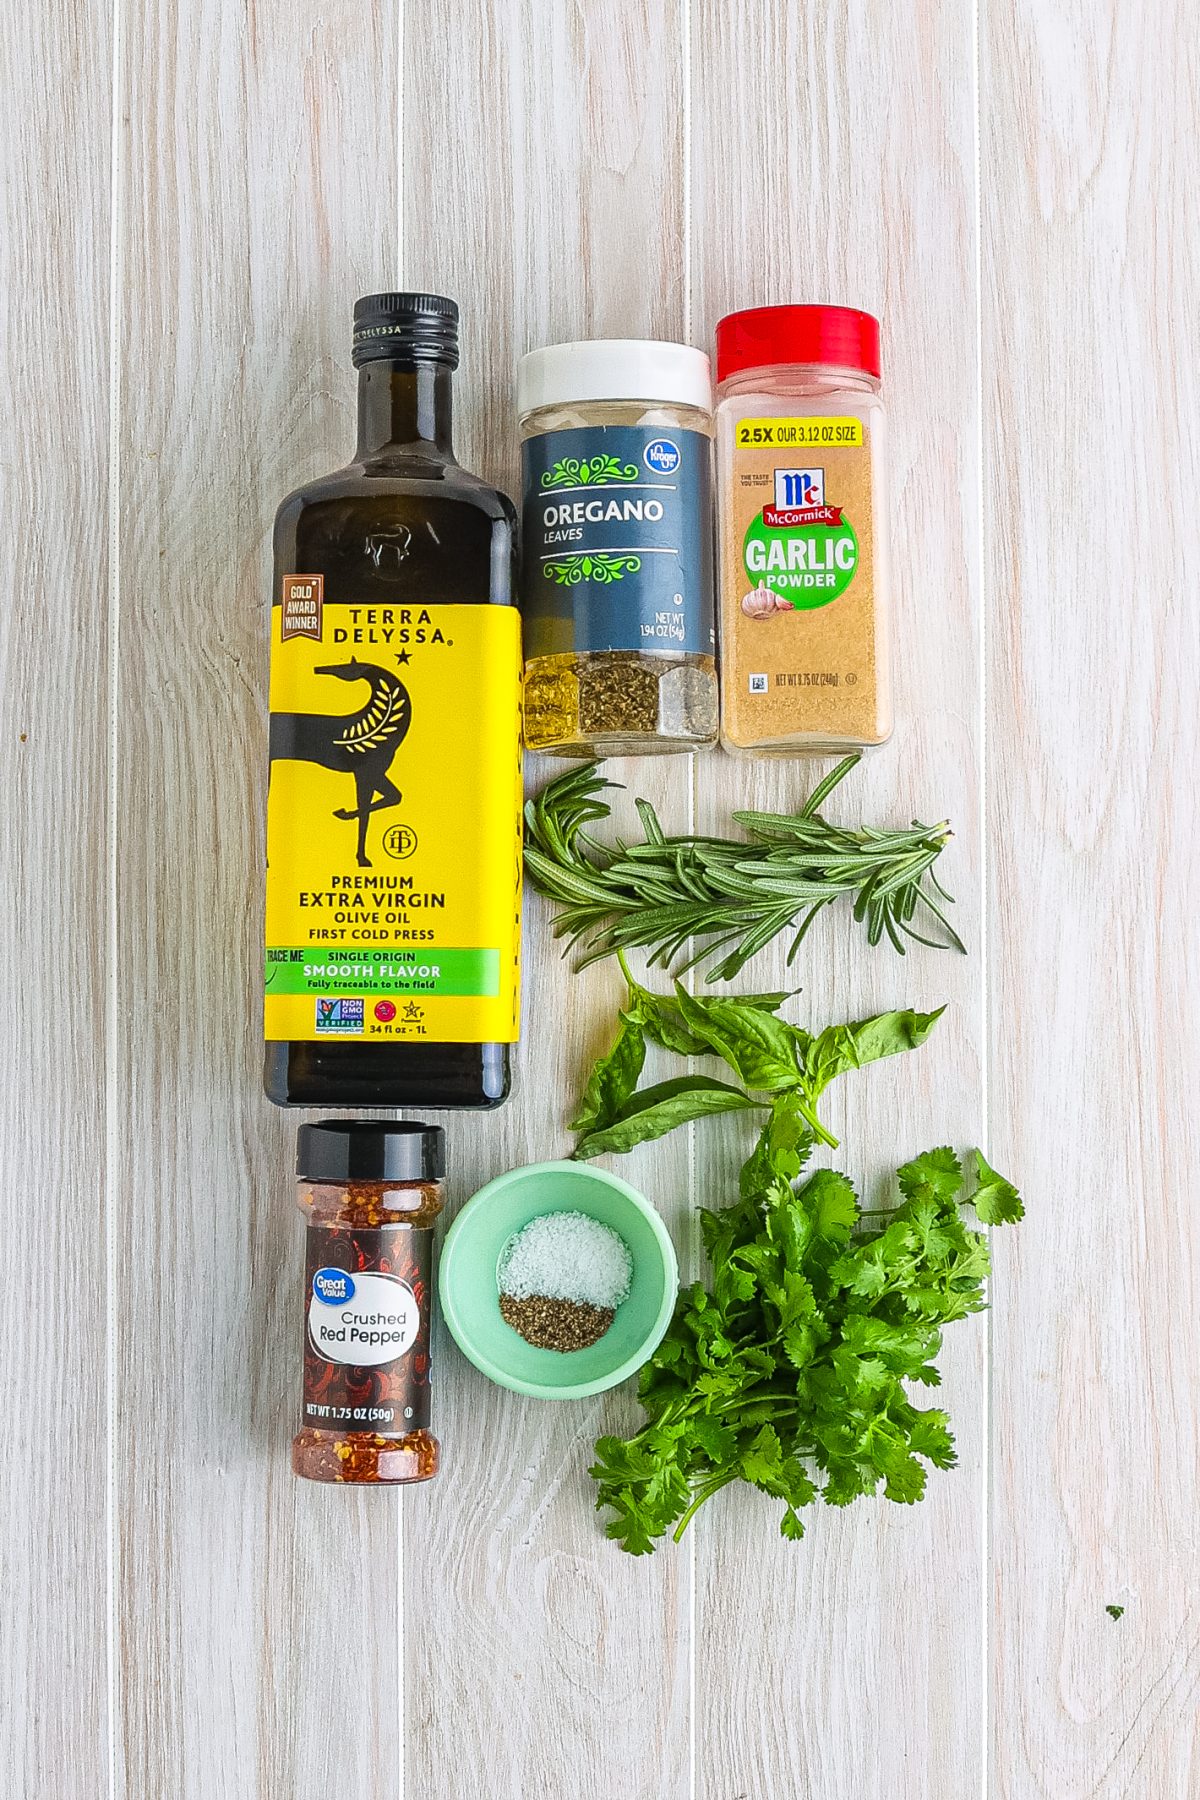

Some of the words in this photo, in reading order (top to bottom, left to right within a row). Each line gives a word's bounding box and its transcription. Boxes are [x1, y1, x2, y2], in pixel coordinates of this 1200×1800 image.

[741, 428, 774, 442] 2.5X
[777, 427, 797, 442] OUR
[799, 426, 820, 441] 3.12
[821, 426, 834, 441] OZ
[837, 426, 856, 441] SIZE
[651, 445, 677, 468] Kroger
[543, 500, 664, 527] OREGANO
[767, 507, 833, 525] McCormick
[544, 528, 583, 544] LEAVES
[745, 538, 855, 572] GARLIC
[766, 573, 836, 588] POWDER
[290, 586, 312, 599] GOLD
[287, 601, 316, 614] AWARD
[285, 616, 318, 630] WINNER
[349, 609, 431, 625] TERRA
[655, 612, 670, 624] NET
[671, 613, 684, 626] WT
[334, 628, 445, 644] DELYSSA
[656, 625, 669, 638] OZ
[331, 876, 414, 889] PREMIUM
[299, 892, 365, 908] EXTRA
[372, 893, 445, 908] VIRGIN
[334, 912, 380, 924] OLIVE
[385, 912, 411, 924] OIL
[308, 929, 347, 940] FIRST
[351, 929, 389, 940] COLD
[394, 929, 435, 940] PRESS
[290, 949, 304, 963] ME
[327, 952, 369, 962] SINGLE
[372, 952, 416, 962] ORIGIN
[303, 965, 374, 978] SMOOTH
[379, 965, 441, 978] FLAVOR
[307, 979, 331, 990] Fully
[333, 980, 378, 989] traceable
[380, 980, 392, 989] to
[393, 980, 410, 989] the
[412, 979, 435, 989] field
[341, 999, 363, 1007] NON
[370, 1025, 381, 1034] 34
[385, 1025, 392, 1033] fl
[395, 1026, 406, 1034] oz
[417, 1026, 427, 1034] 1L
[317, 1276, 346, 1289] Great
[322, 1288, 346, 1299] Value
[341, 1312, 407, 1325] Crushed
[320, 1326, 346, 1342] Red
[351, 1328, 406, 1346] Pepper
[306, 1403, 317, 1415] NET
[318, 1405, 330, 1417] WT
[331, 1407, 352, 1419] 1.75
[353, 1408, 367, 1420] OZ
[368, 1407, 395, 1422] (50g)
